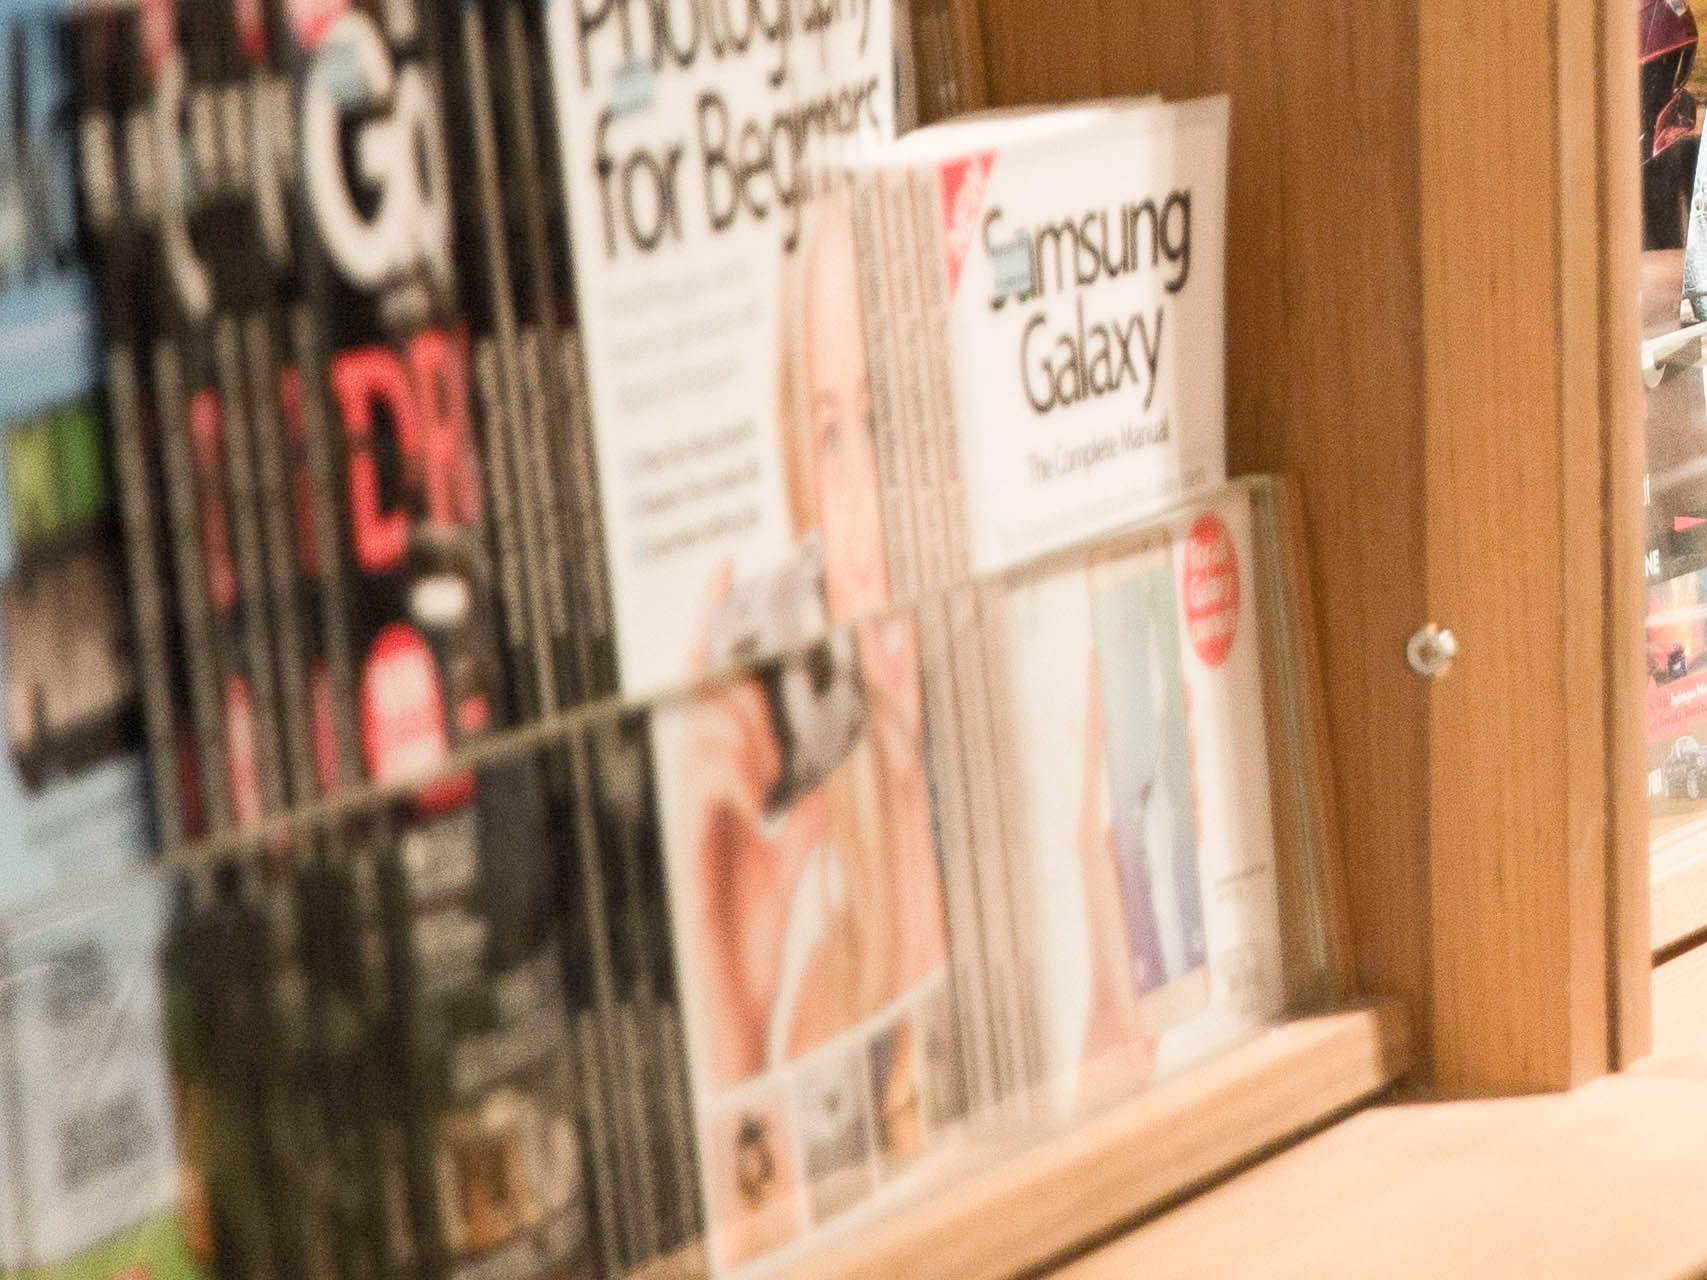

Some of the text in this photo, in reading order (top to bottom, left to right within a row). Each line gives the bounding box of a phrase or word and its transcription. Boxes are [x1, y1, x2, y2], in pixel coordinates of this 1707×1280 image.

[594, 103, 684, 259] for
[980, 187, 1193, 313] Samsung
[1018, 295, 1165, 417] Galaxy
